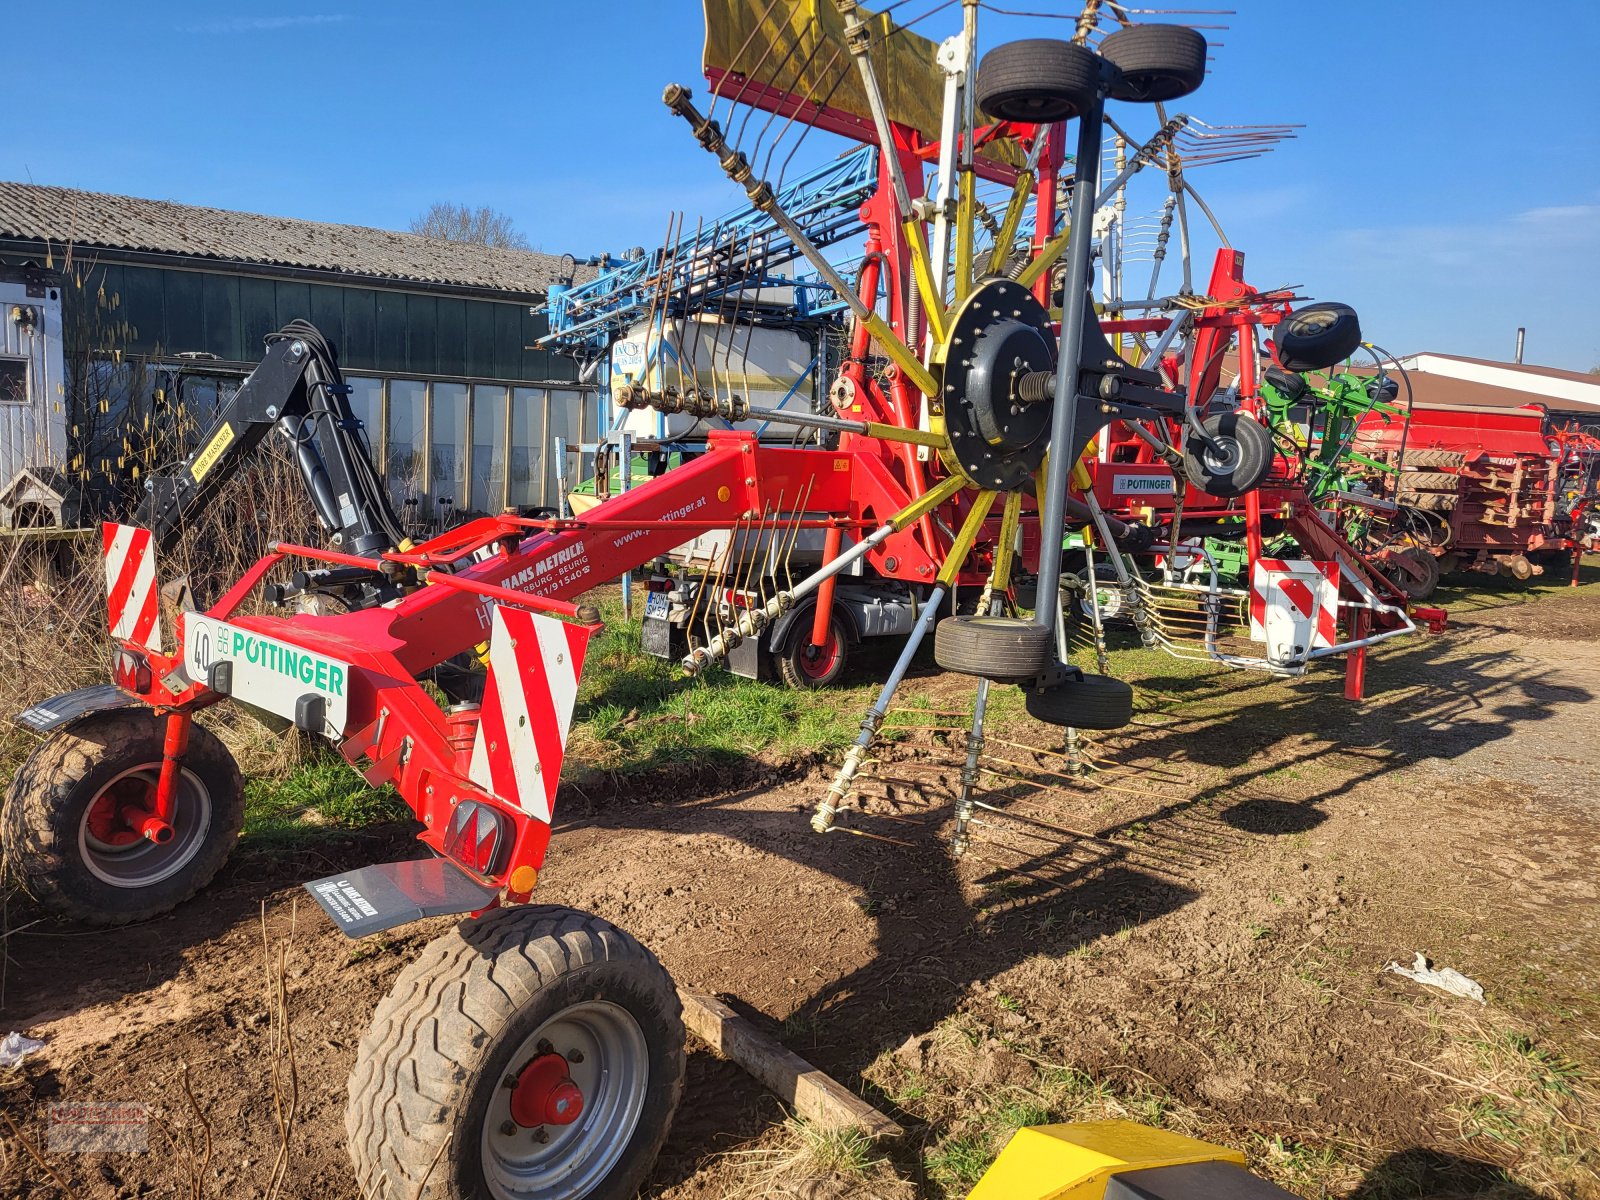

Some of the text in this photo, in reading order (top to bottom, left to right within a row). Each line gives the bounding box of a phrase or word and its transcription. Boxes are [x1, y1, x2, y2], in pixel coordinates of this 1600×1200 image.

[558, 555, 589, 576] BEURIG
[501, 565, 535, 590] HANS
[652, 595, 666, 605] HOM
[194, 631, 210, 671] 40
